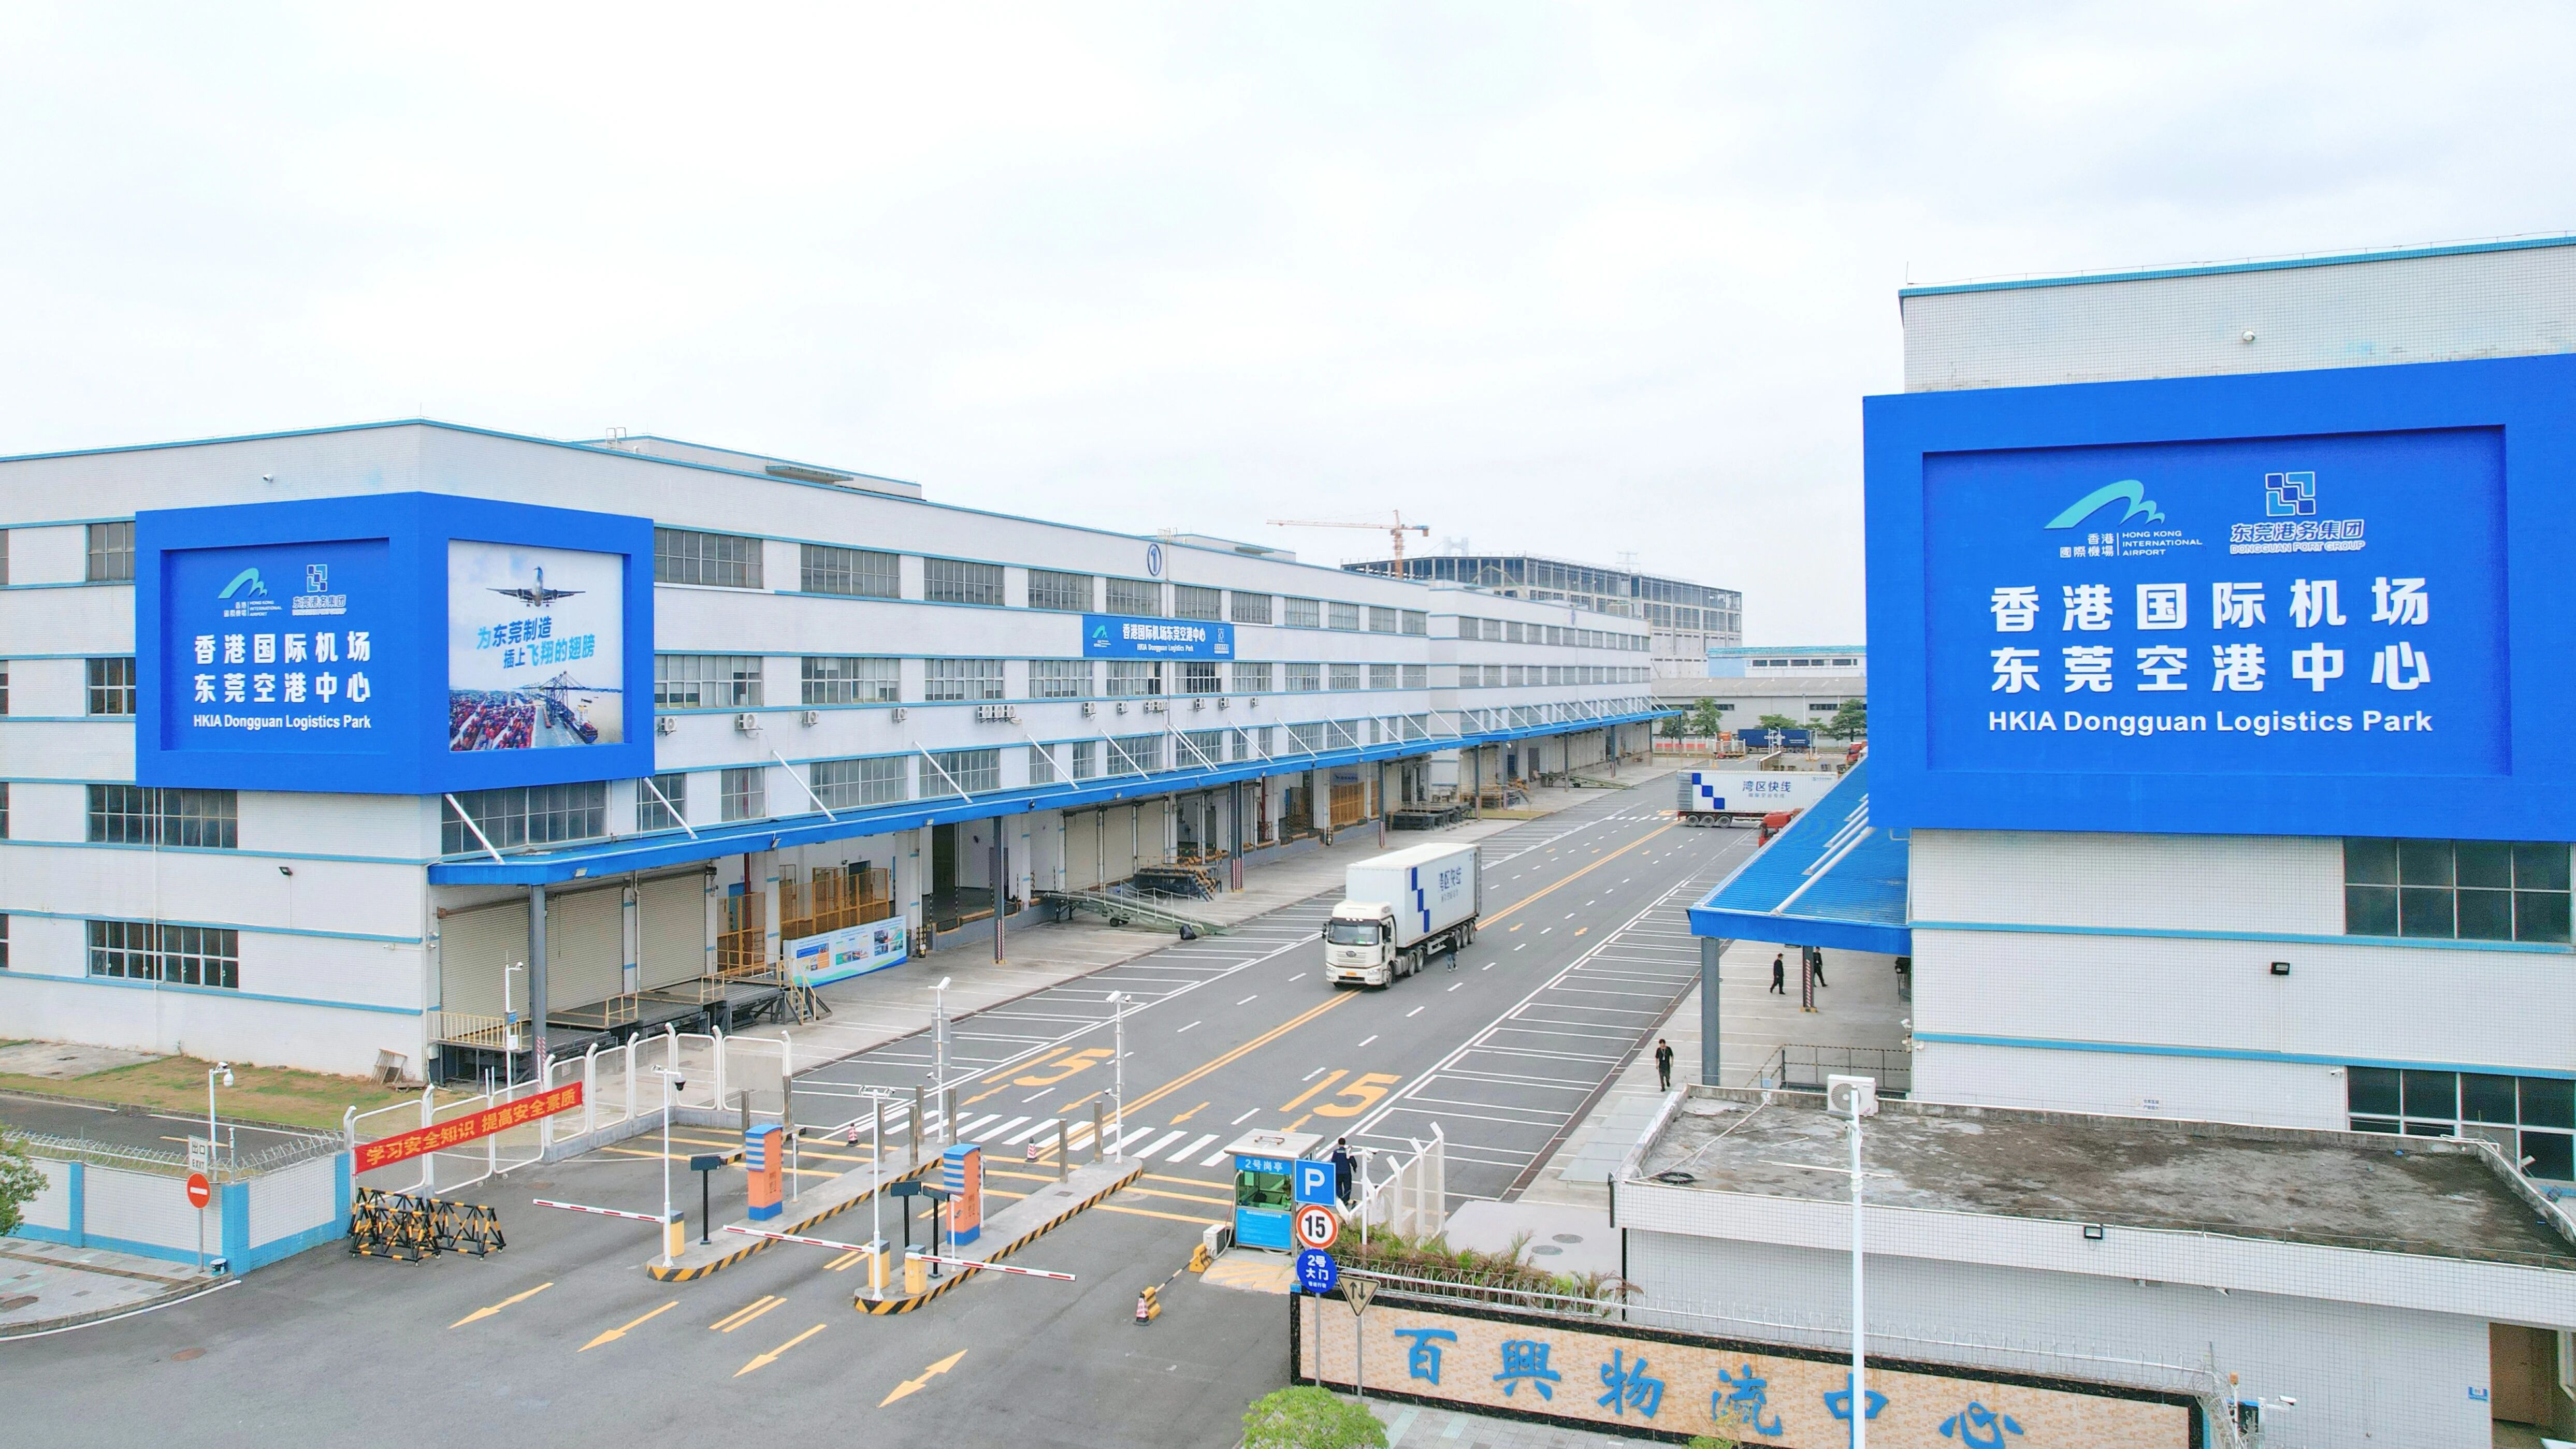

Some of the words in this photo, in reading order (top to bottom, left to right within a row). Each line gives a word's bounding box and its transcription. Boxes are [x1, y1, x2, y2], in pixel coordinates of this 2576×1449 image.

[2088, 533, 2115, 545] 香港
[2230, 519, 2364, 543] 东莞港务集团
[2060, 545, 2115, 558] 國際機場
[2122, 539, 2203, 547] INTERNATIONAL
[2230, 544, 2292, 554] DONGGUAN
[2292, 542, 2323, 553] PORT
[2324, 540, 2365, 551] GROUP
[293, 595, 346, 608] 东莞港务集团
[1990, 577, 2429, 632] 香港国际机场
[476, 615, 552, 650] 为东莞制造
[1123, 623, 1206, 643] 香港国际机场东莞空港中心
[194, 631, 371, 664] 香港国际机场
[503, 633, 596, 669] 插上飞翔的翅膀
[1148, 644, 1168, 653] Dongguan
[1168, 644, 1185, 653] Logistics
[1990, 641, 2431, 694] 东莞空港中心
[194, 672, 371, 704] 东莞空港中心
[194, 715, 222, 728] HKIA
[224, 715, 283, 731] Dongguan
[286, 715, 341, 731] Logistics
[343, 715, 372, 729] Park
[1989, 711, 2058, 731] HKIA
[2064, 711, 2206, 736] Dongguan
[2217, 711, 2353, 736] Logistics
[2363, 710, 2433, 732] Park
[1742, 780, 1791, 792] 湾区快线
[980, 1047, 1115, 1086] 15
[1278, 1069, 1402, 1117] 15
[366, 1119, 475, 1166] 学习安全知识
[481, 1088, 576, 1133] 提高安全素质
[192, 1141, 206, 1155] 出口
[192, 1158, 205, 1170] EXIT
[1244, 1158, 1283, 1172] 2号岗亭
[1305, 1168, 1325, 1196] P
[1305, 1215, 1326, 1239] 15
[1307, 1254, 1326, 1268] 2号
[1306, 1267, 1329, 1281] 大门
[1394, 1328, 2024, 1449] 百興物流中心
